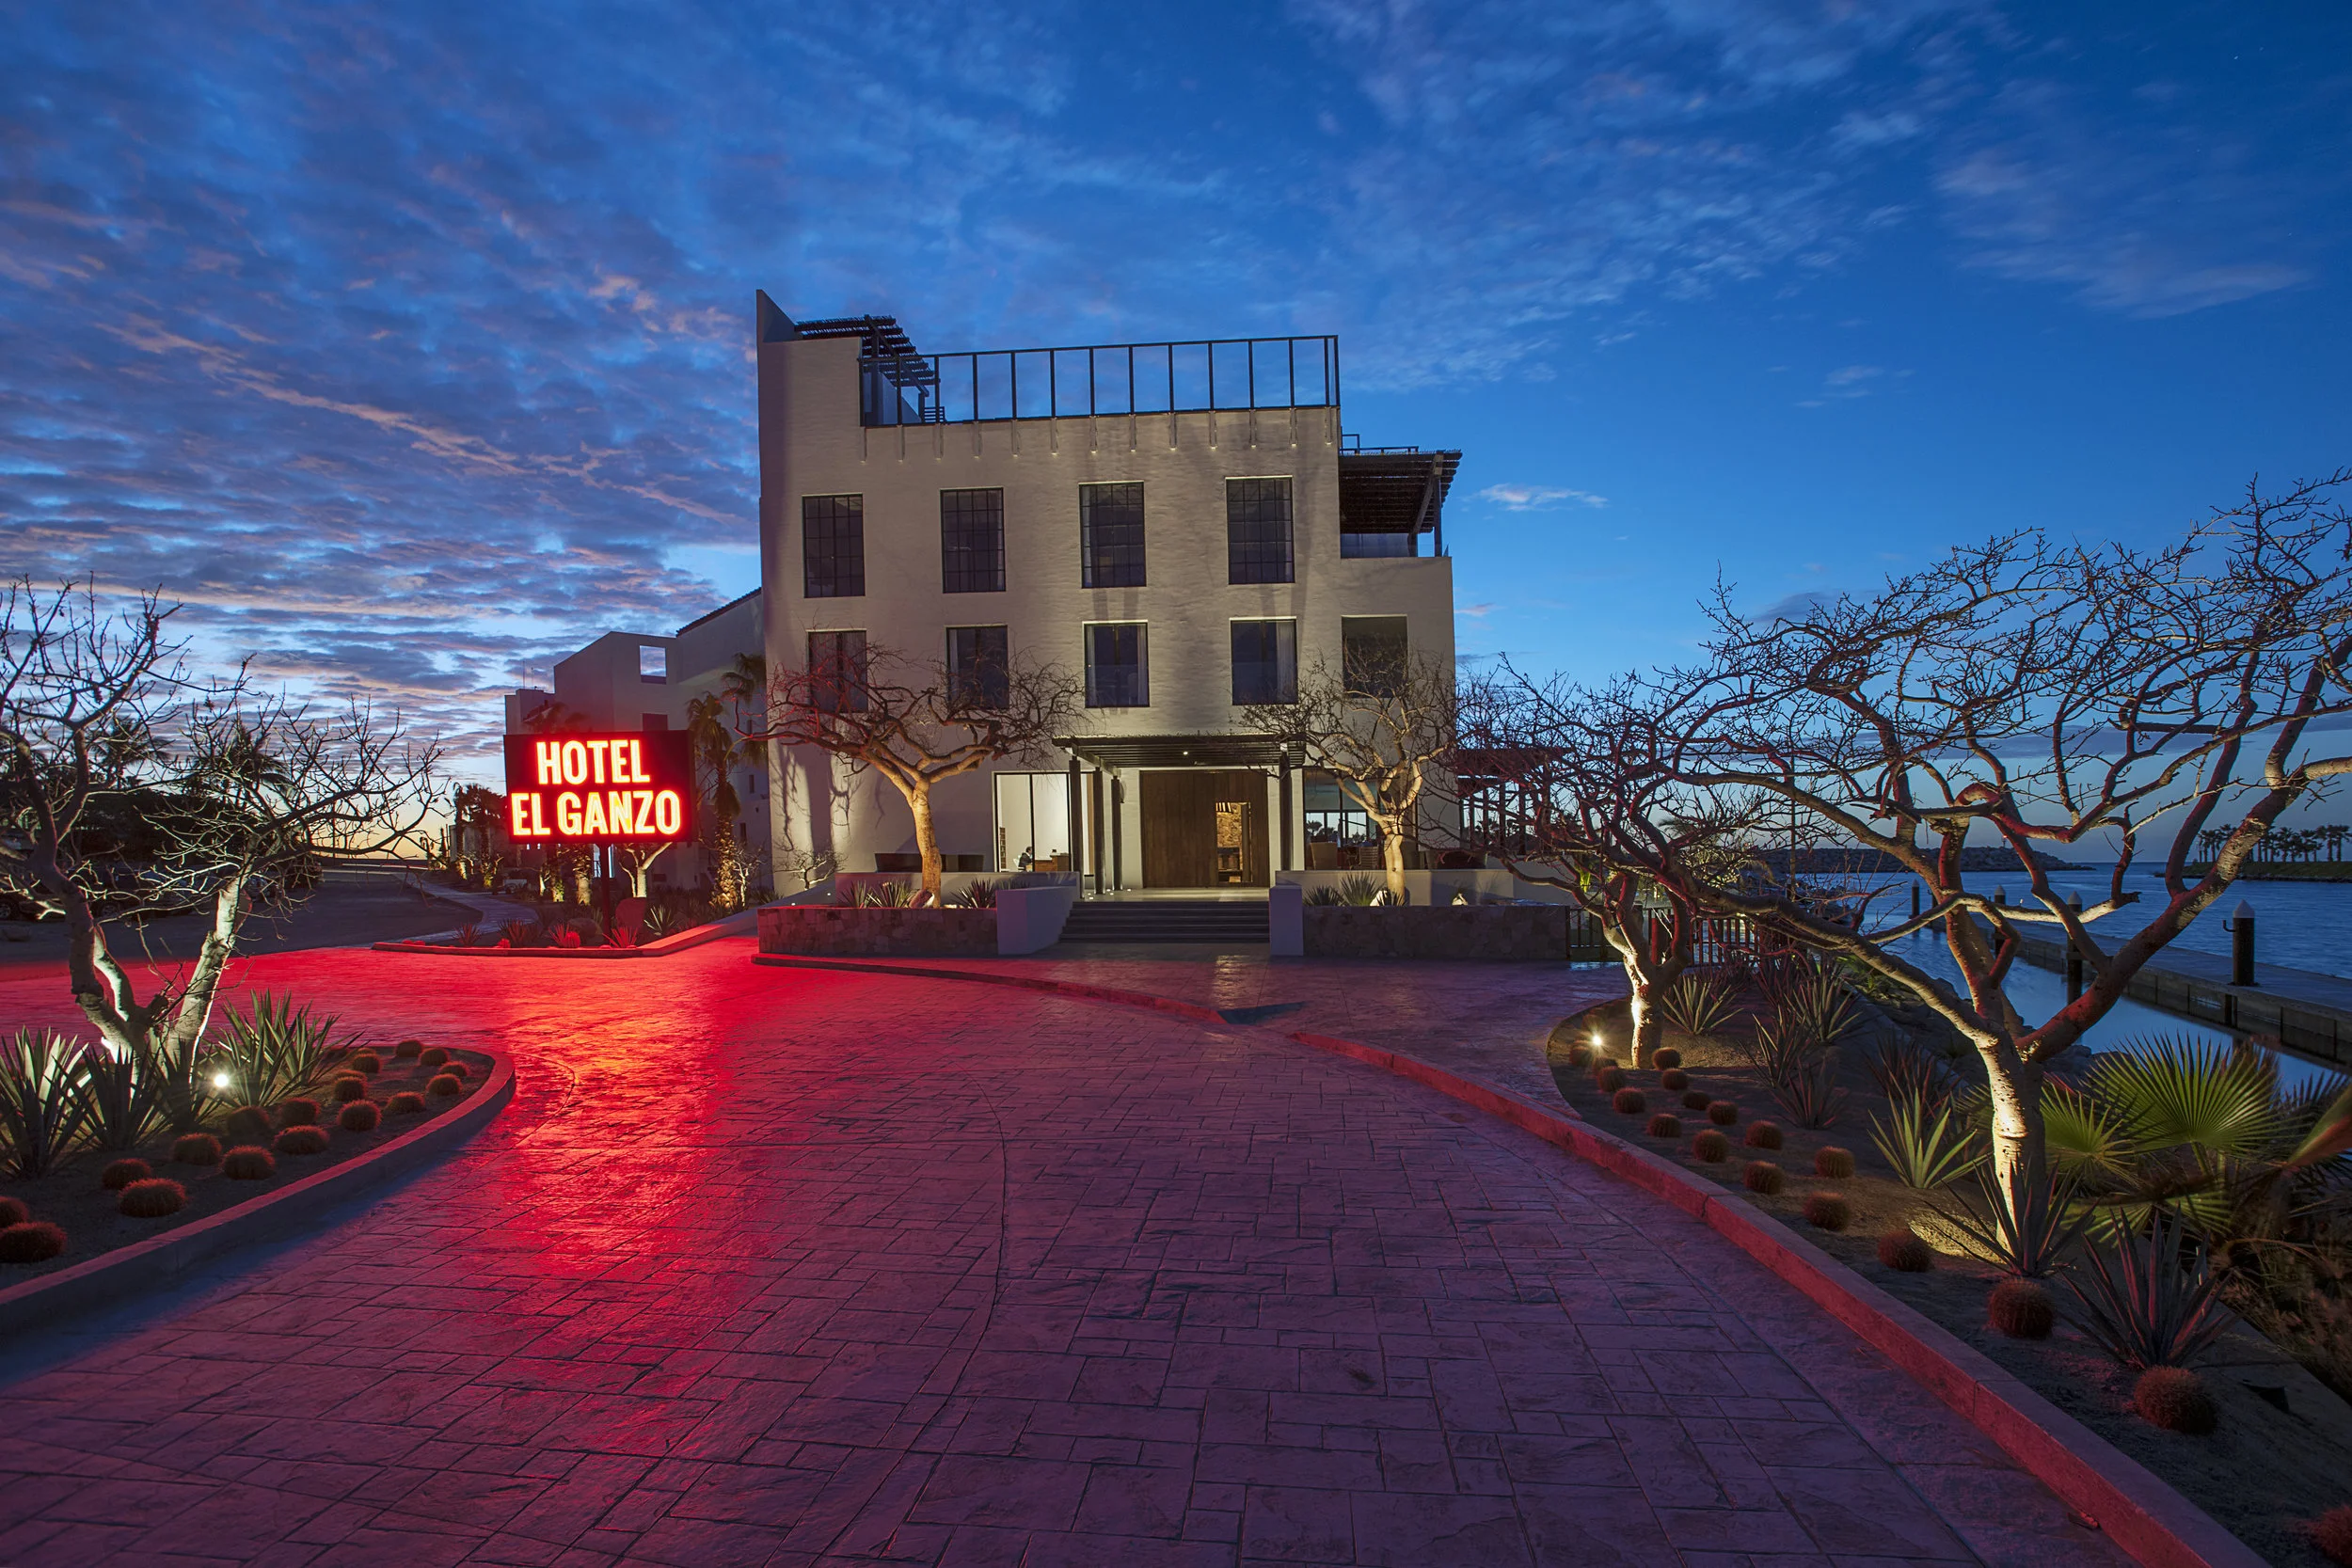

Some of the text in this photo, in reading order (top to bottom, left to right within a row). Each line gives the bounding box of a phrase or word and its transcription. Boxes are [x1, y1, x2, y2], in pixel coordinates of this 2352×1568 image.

[536, 739, 651, 784] HOTEL
[511, 789, 681, 836] EL GANZO
